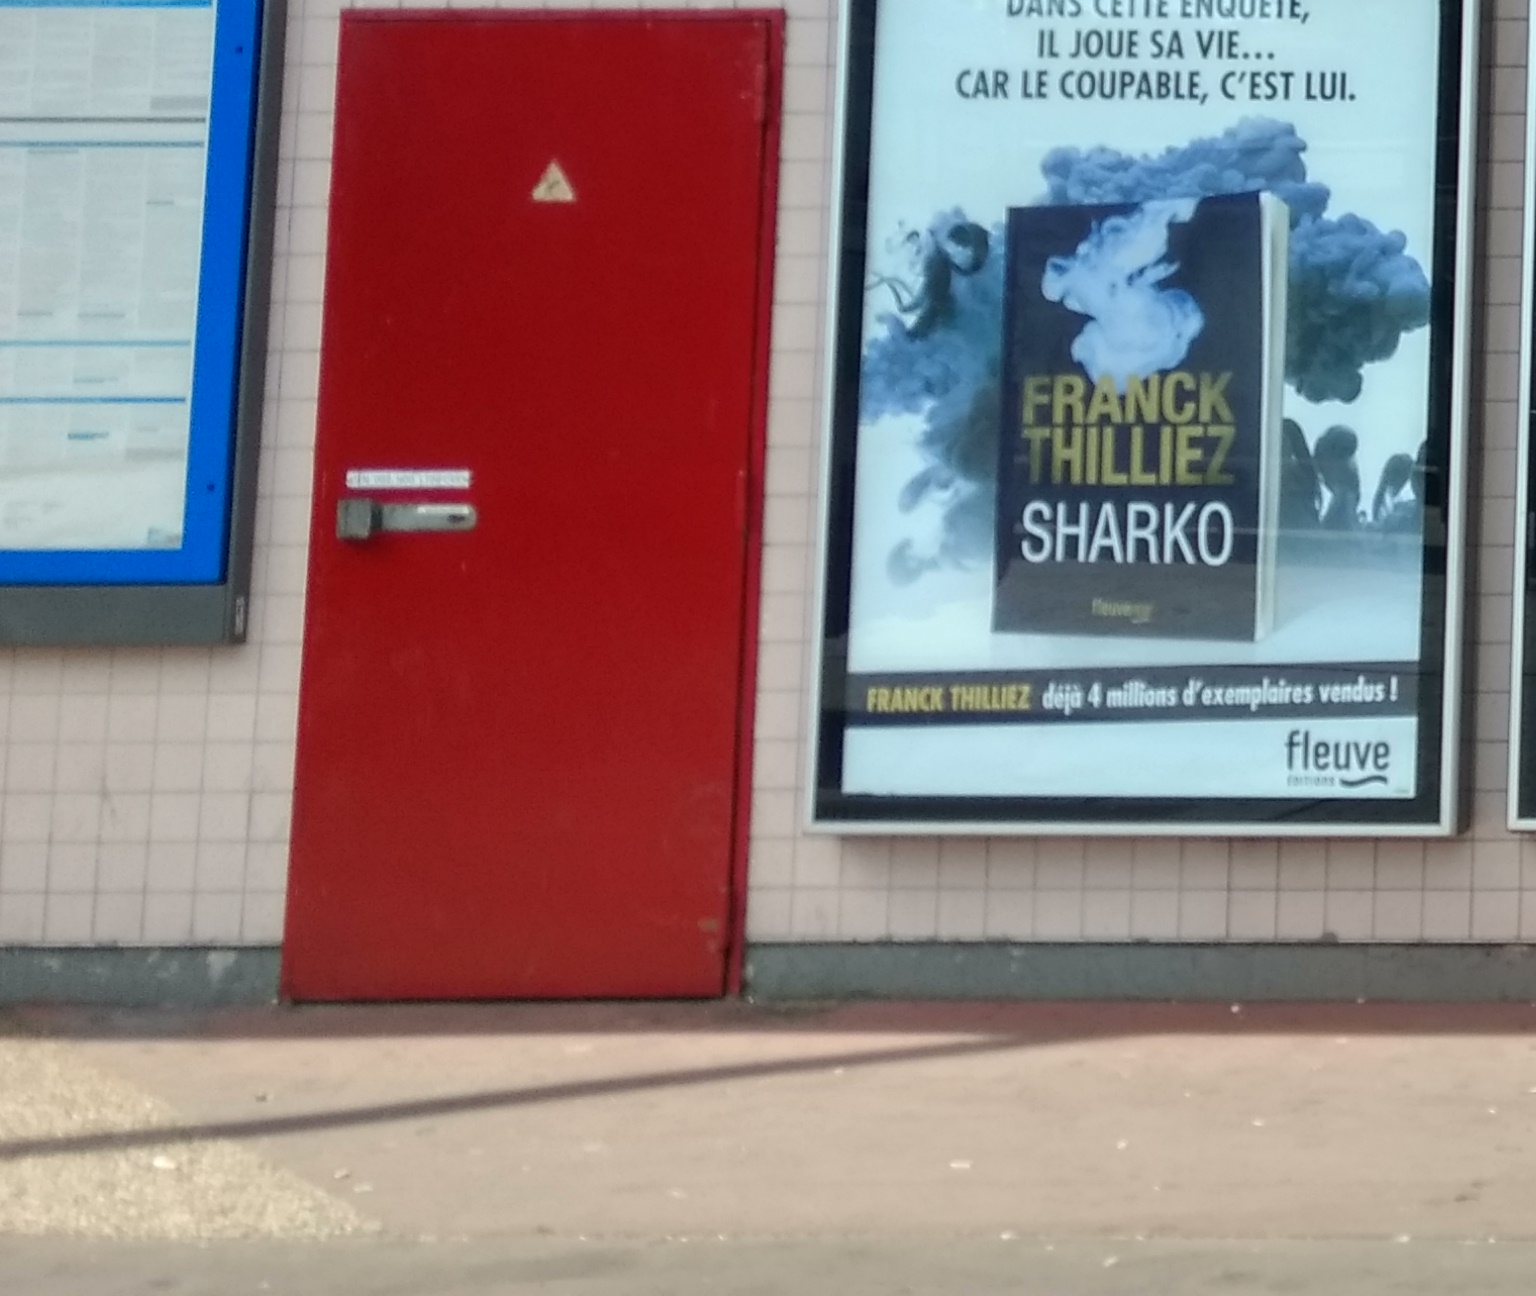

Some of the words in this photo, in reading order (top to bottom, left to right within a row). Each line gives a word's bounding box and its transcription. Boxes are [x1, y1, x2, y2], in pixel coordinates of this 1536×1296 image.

[1037, 30, 1060, 59] IL
[1070, 30, 1139, 59] JOUE
[1150, 30, 1185, 59] SA
[1196, 29, 1276, 59] VIE...
[955, 70, 1010, 100] CAR
[1021, 70, 1048, 100] LE
[1060, 70, 1209, 105] COUPABLE,
[1221, 71, 1295, 101] C'EST
[1305, 71, 1357, 102] LUI.
[1022, 371, 1235, 425] FRANCK
[1021, 425, 1236, 486] THILLIEZ
[1021, 500, 1234, 566] SHARKO
[866, 686, 944, 713] FRANCK
[951, 683, 1031, 711] THILLIEZ
[1042, 681, 1083, 716] déjà
[1087, 681, 1103, 708] 4
[1106, 678, 1177, 708] millions
[1182, 675, 1313, 712] d'exemplaires
[1318, 674, 1386, 704] vendus
[1285, 730, 1390, 771] fleuve
